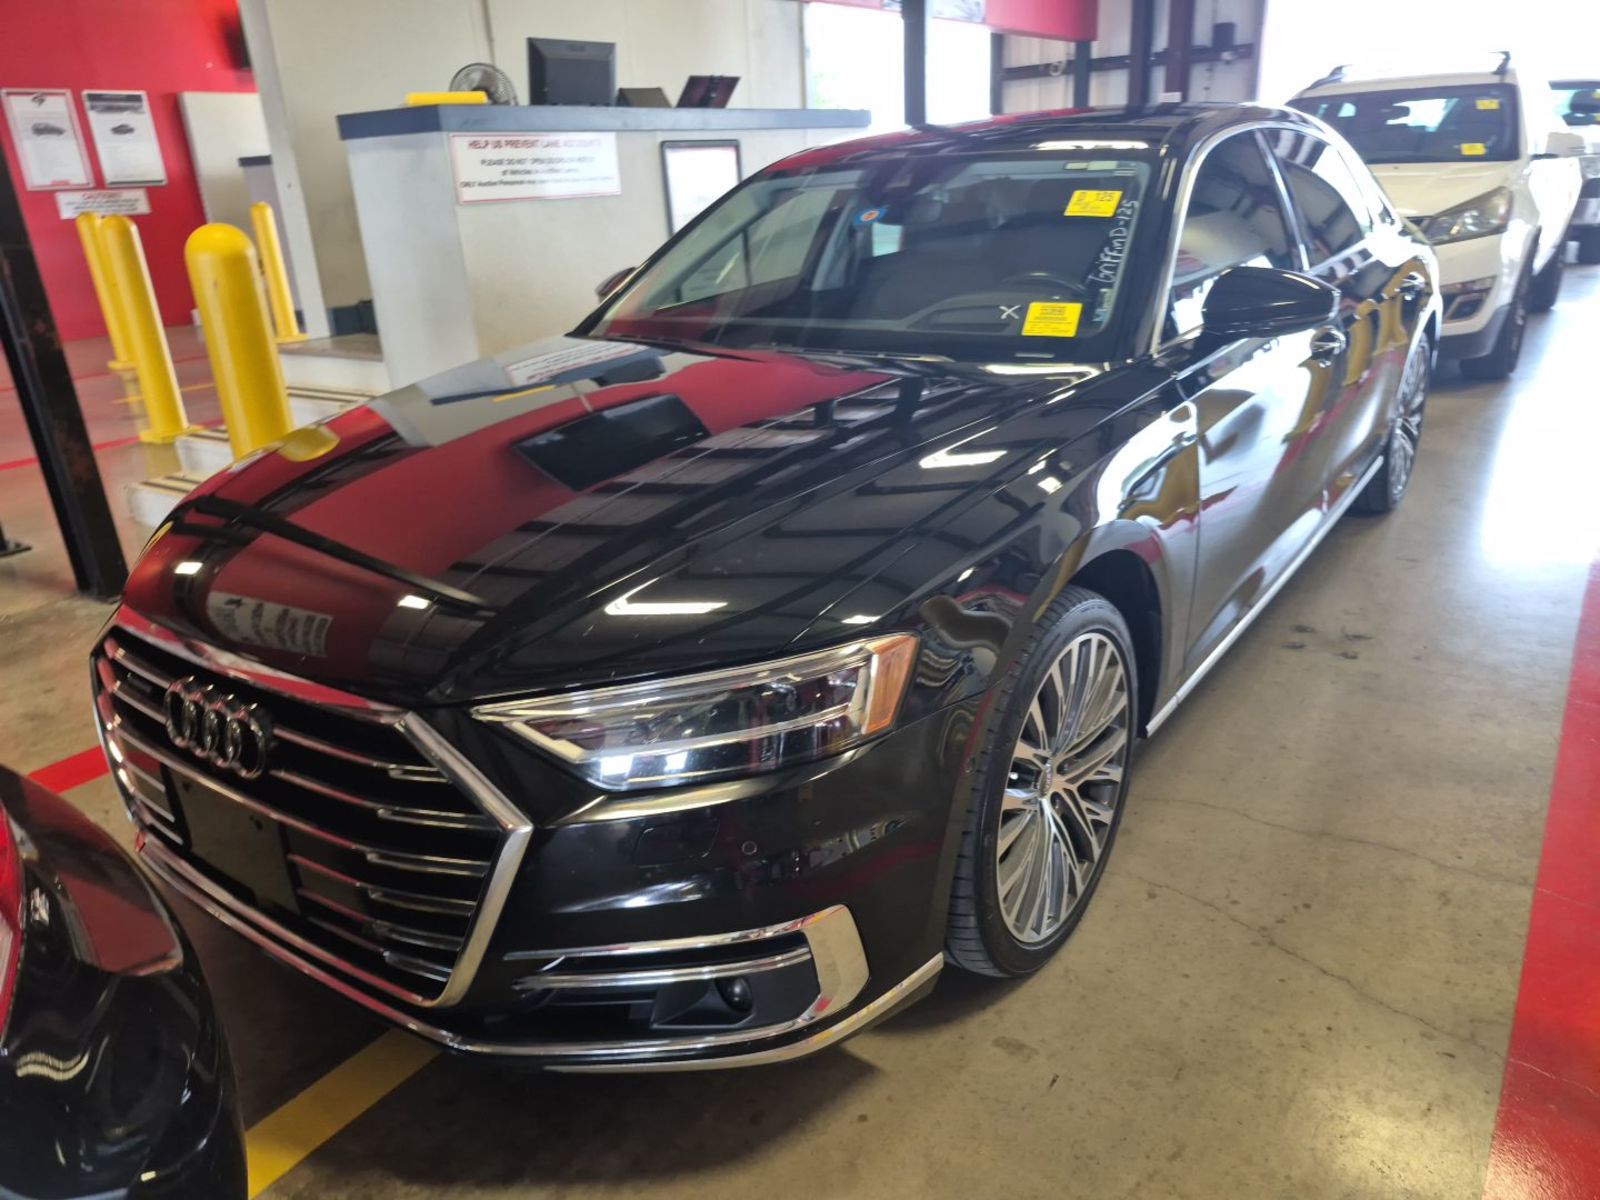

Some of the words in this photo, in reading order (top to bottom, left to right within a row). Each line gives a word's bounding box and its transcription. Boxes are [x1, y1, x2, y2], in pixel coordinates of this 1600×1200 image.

[468, 139, 489, 150] HELP
[491, 139, 502, 150] US
[504, 138, 540, 149] PREVENT
